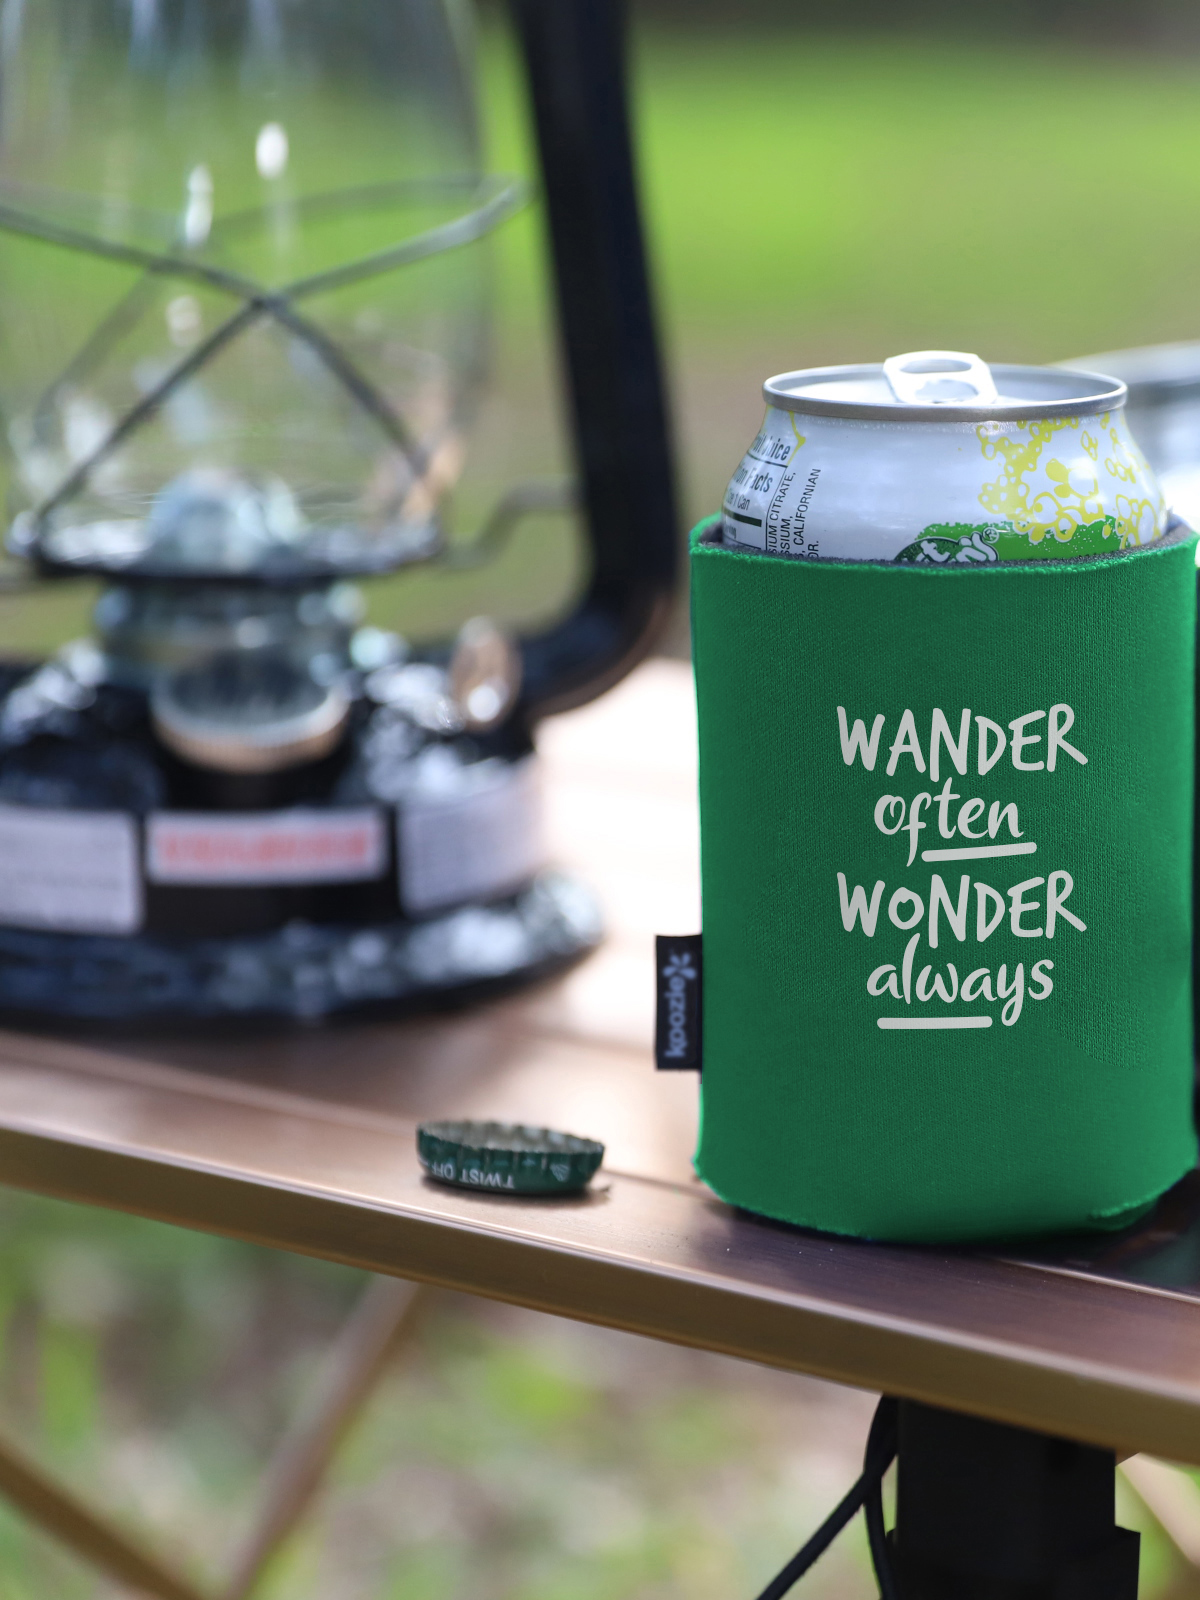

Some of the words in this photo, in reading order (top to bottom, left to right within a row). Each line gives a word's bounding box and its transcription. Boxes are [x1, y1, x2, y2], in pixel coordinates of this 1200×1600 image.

[769, 472, 797, 521] CITRATE,
[793, 468, 821, 546] CALIFORNIAN
[768, 525, 778, 553] SIUM
[780, 515, 794, 555] SSIUM,
[807, 540, 819, 558] OR.
[837, 703, 1089, 782] WANDER
[873, 776, 1024, 867] often
[837, 870, 1088, 949] WONDER
[866, 933, 1055, 1027] always
[664, 976, 688, 1058] koozie
[431, 1162, 454, 1181] OFF
[459, 1168, 515, 1189] TWIST
